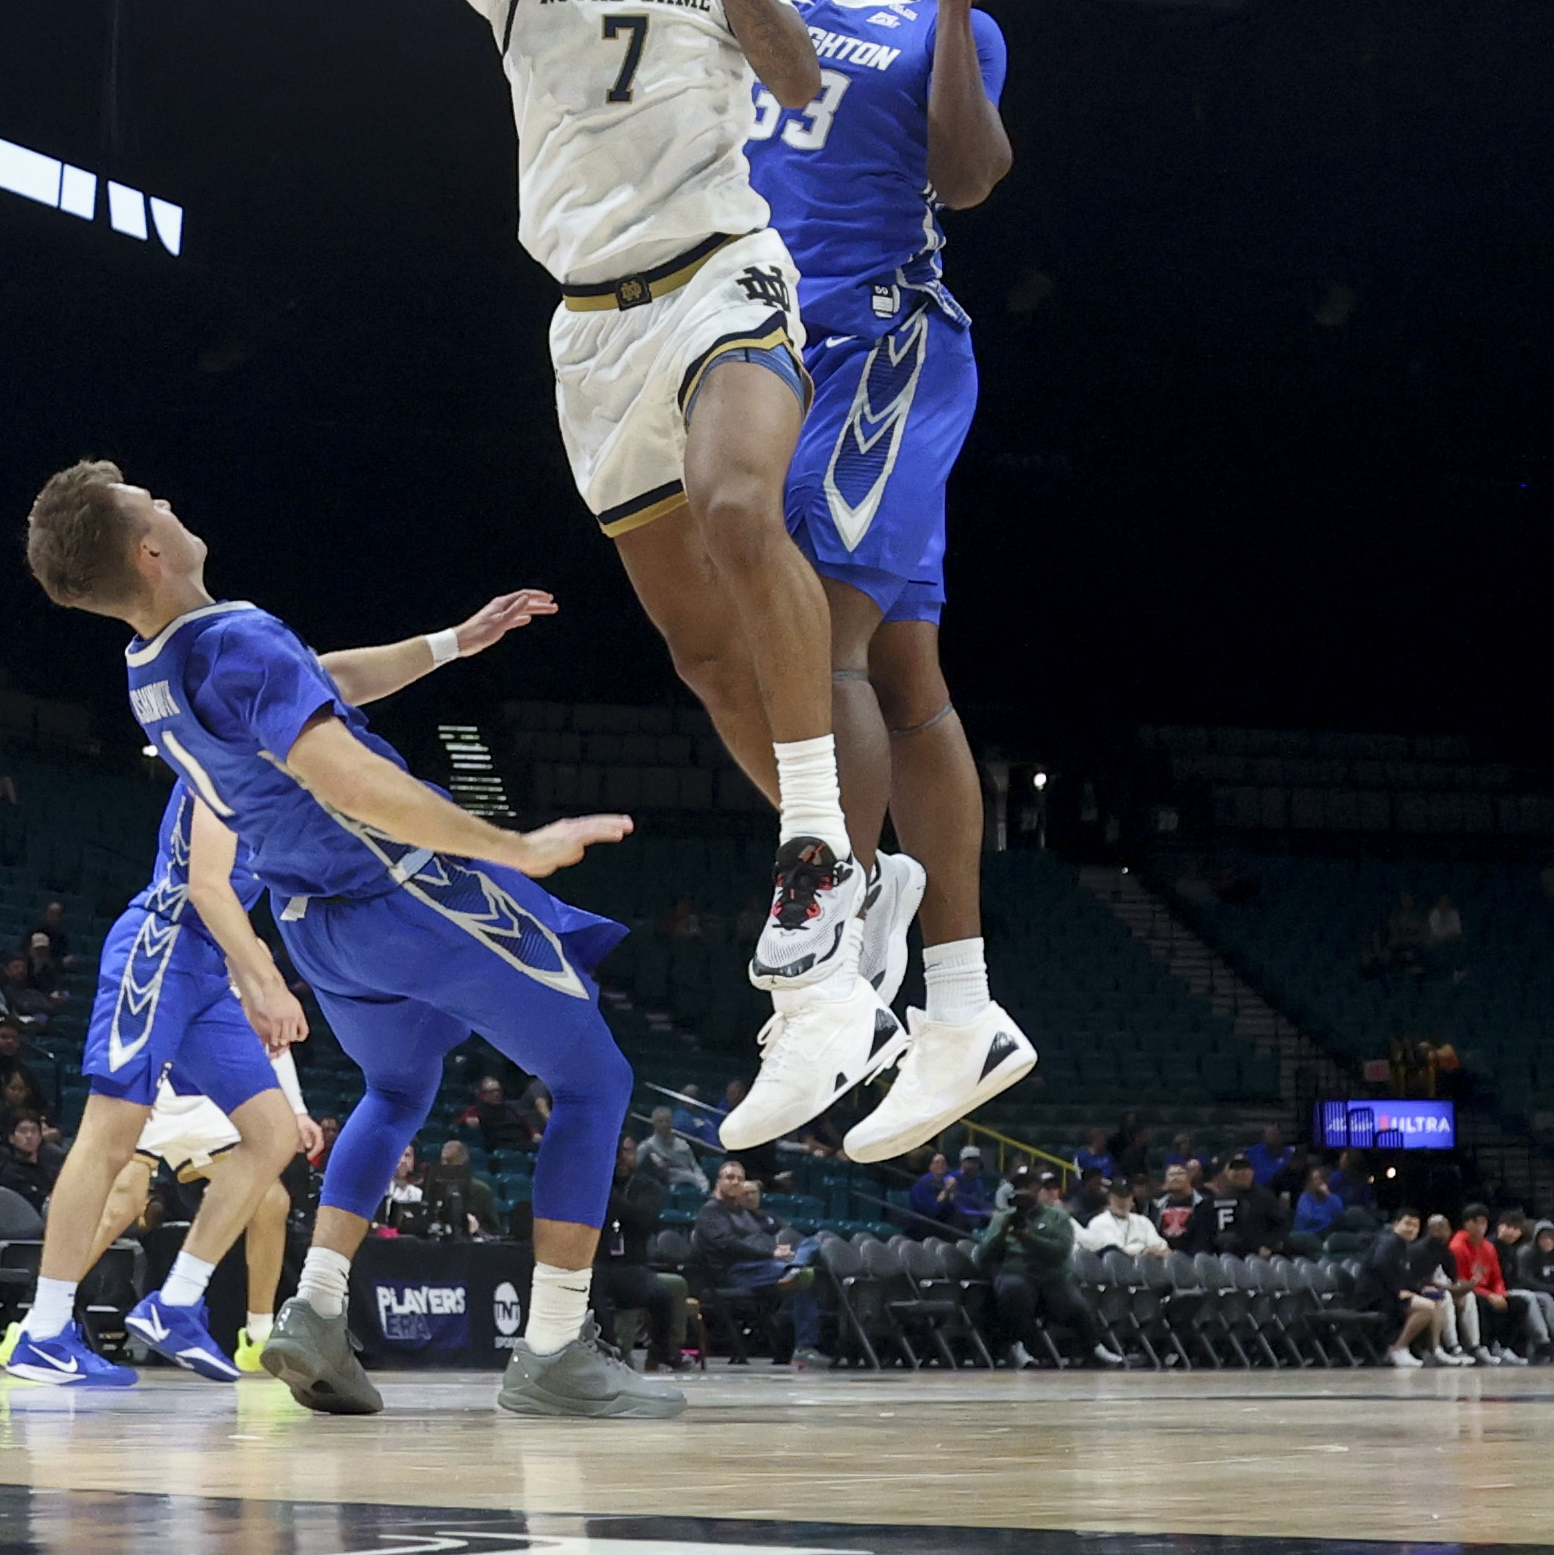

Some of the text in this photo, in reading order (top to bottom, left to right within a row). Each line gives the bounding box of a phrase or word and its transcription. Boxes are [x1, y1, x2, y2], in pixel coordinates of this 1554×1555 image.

[601, 12, 650, 104] 7
[161, 730, 237, 818] 1
[376, 1285, 466, 1317] PLAYERS
[385, 1314, 432, 1340] ERA
